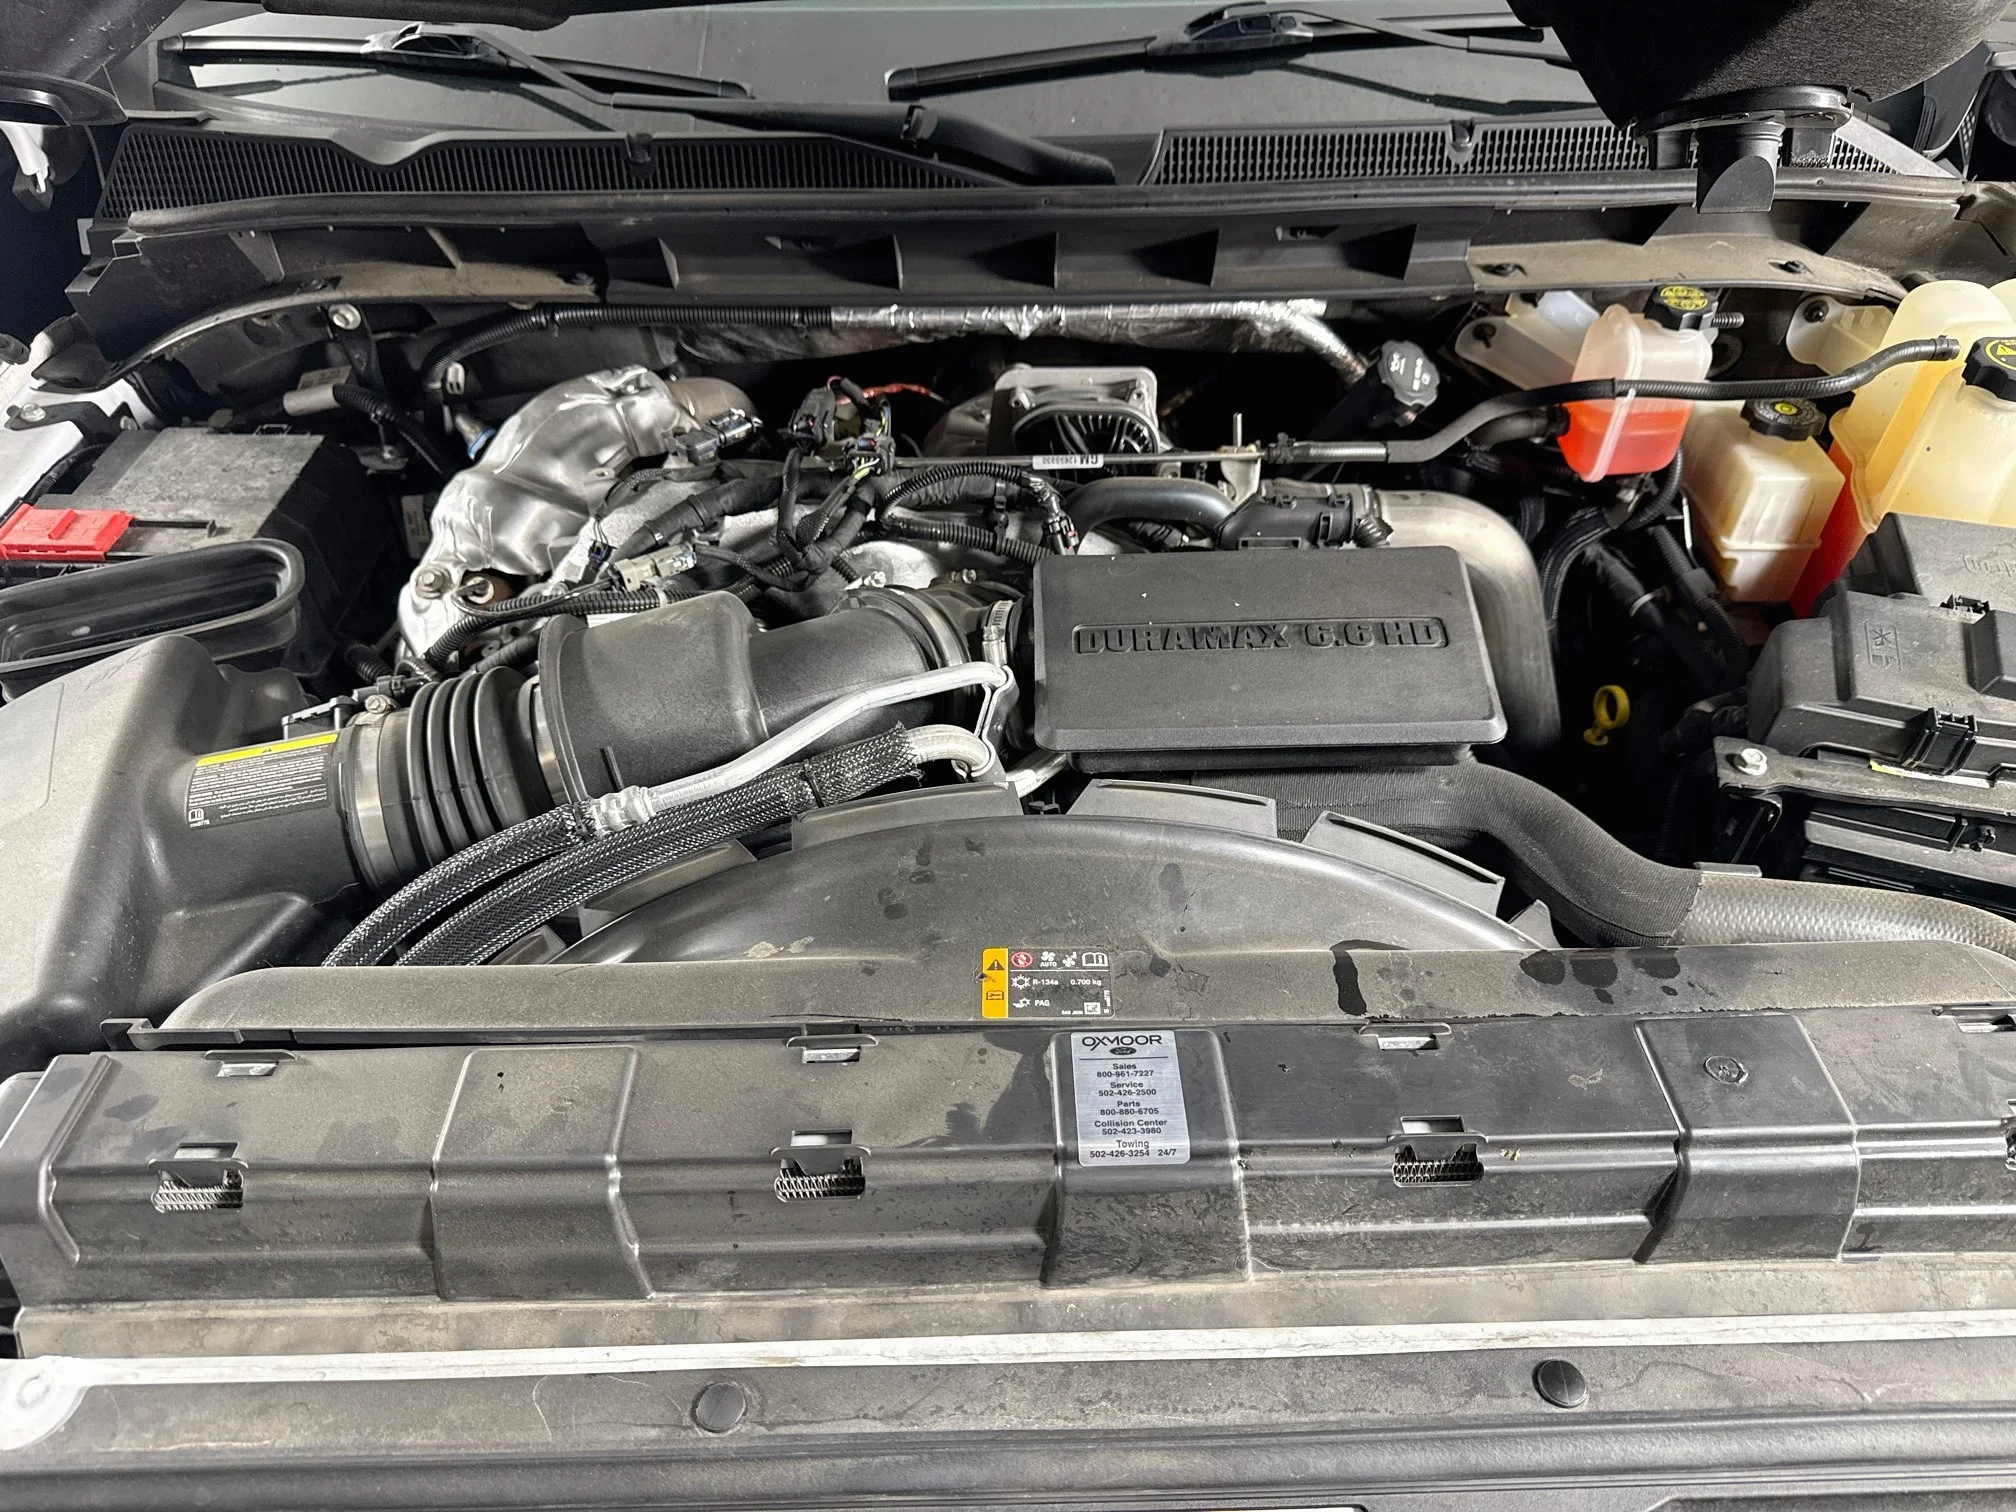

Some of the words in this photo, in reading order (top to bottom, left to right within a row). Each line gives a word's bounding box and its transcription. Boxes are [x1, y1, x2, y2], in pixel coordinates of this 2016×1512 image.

[1077, 622, 1291, 654] DURAMAX
[1304, 621, 1375, 649] 6.6
[1381, 618, 1442, 648] HD
[1082, 1034, 1163, 1051] OXMOOR
[1112, 1047, 1134, 1055] Ford
[1112, 1062, 1137, 1070] Sales
[1096, 1070, 1154, 1078] 800-961-7227
[1110, 1081, 1144, 1089] Service
[1117, 1100, 1141, 1108] Parts
[1100, 1108, 1159, 1116] 800-880-6705
[1094, 1120, 1135, 1128] Collision
[1137, 1119, 1167, 1127] Center
[1102, 1127, 1162, 1135] 502-423-3980
[1116, 1140, 1149, 1149] Towing
[1089, 1150, 1150, 1158] 502-426-3254
[1157, 1149, 1177, 1157] 24/7
